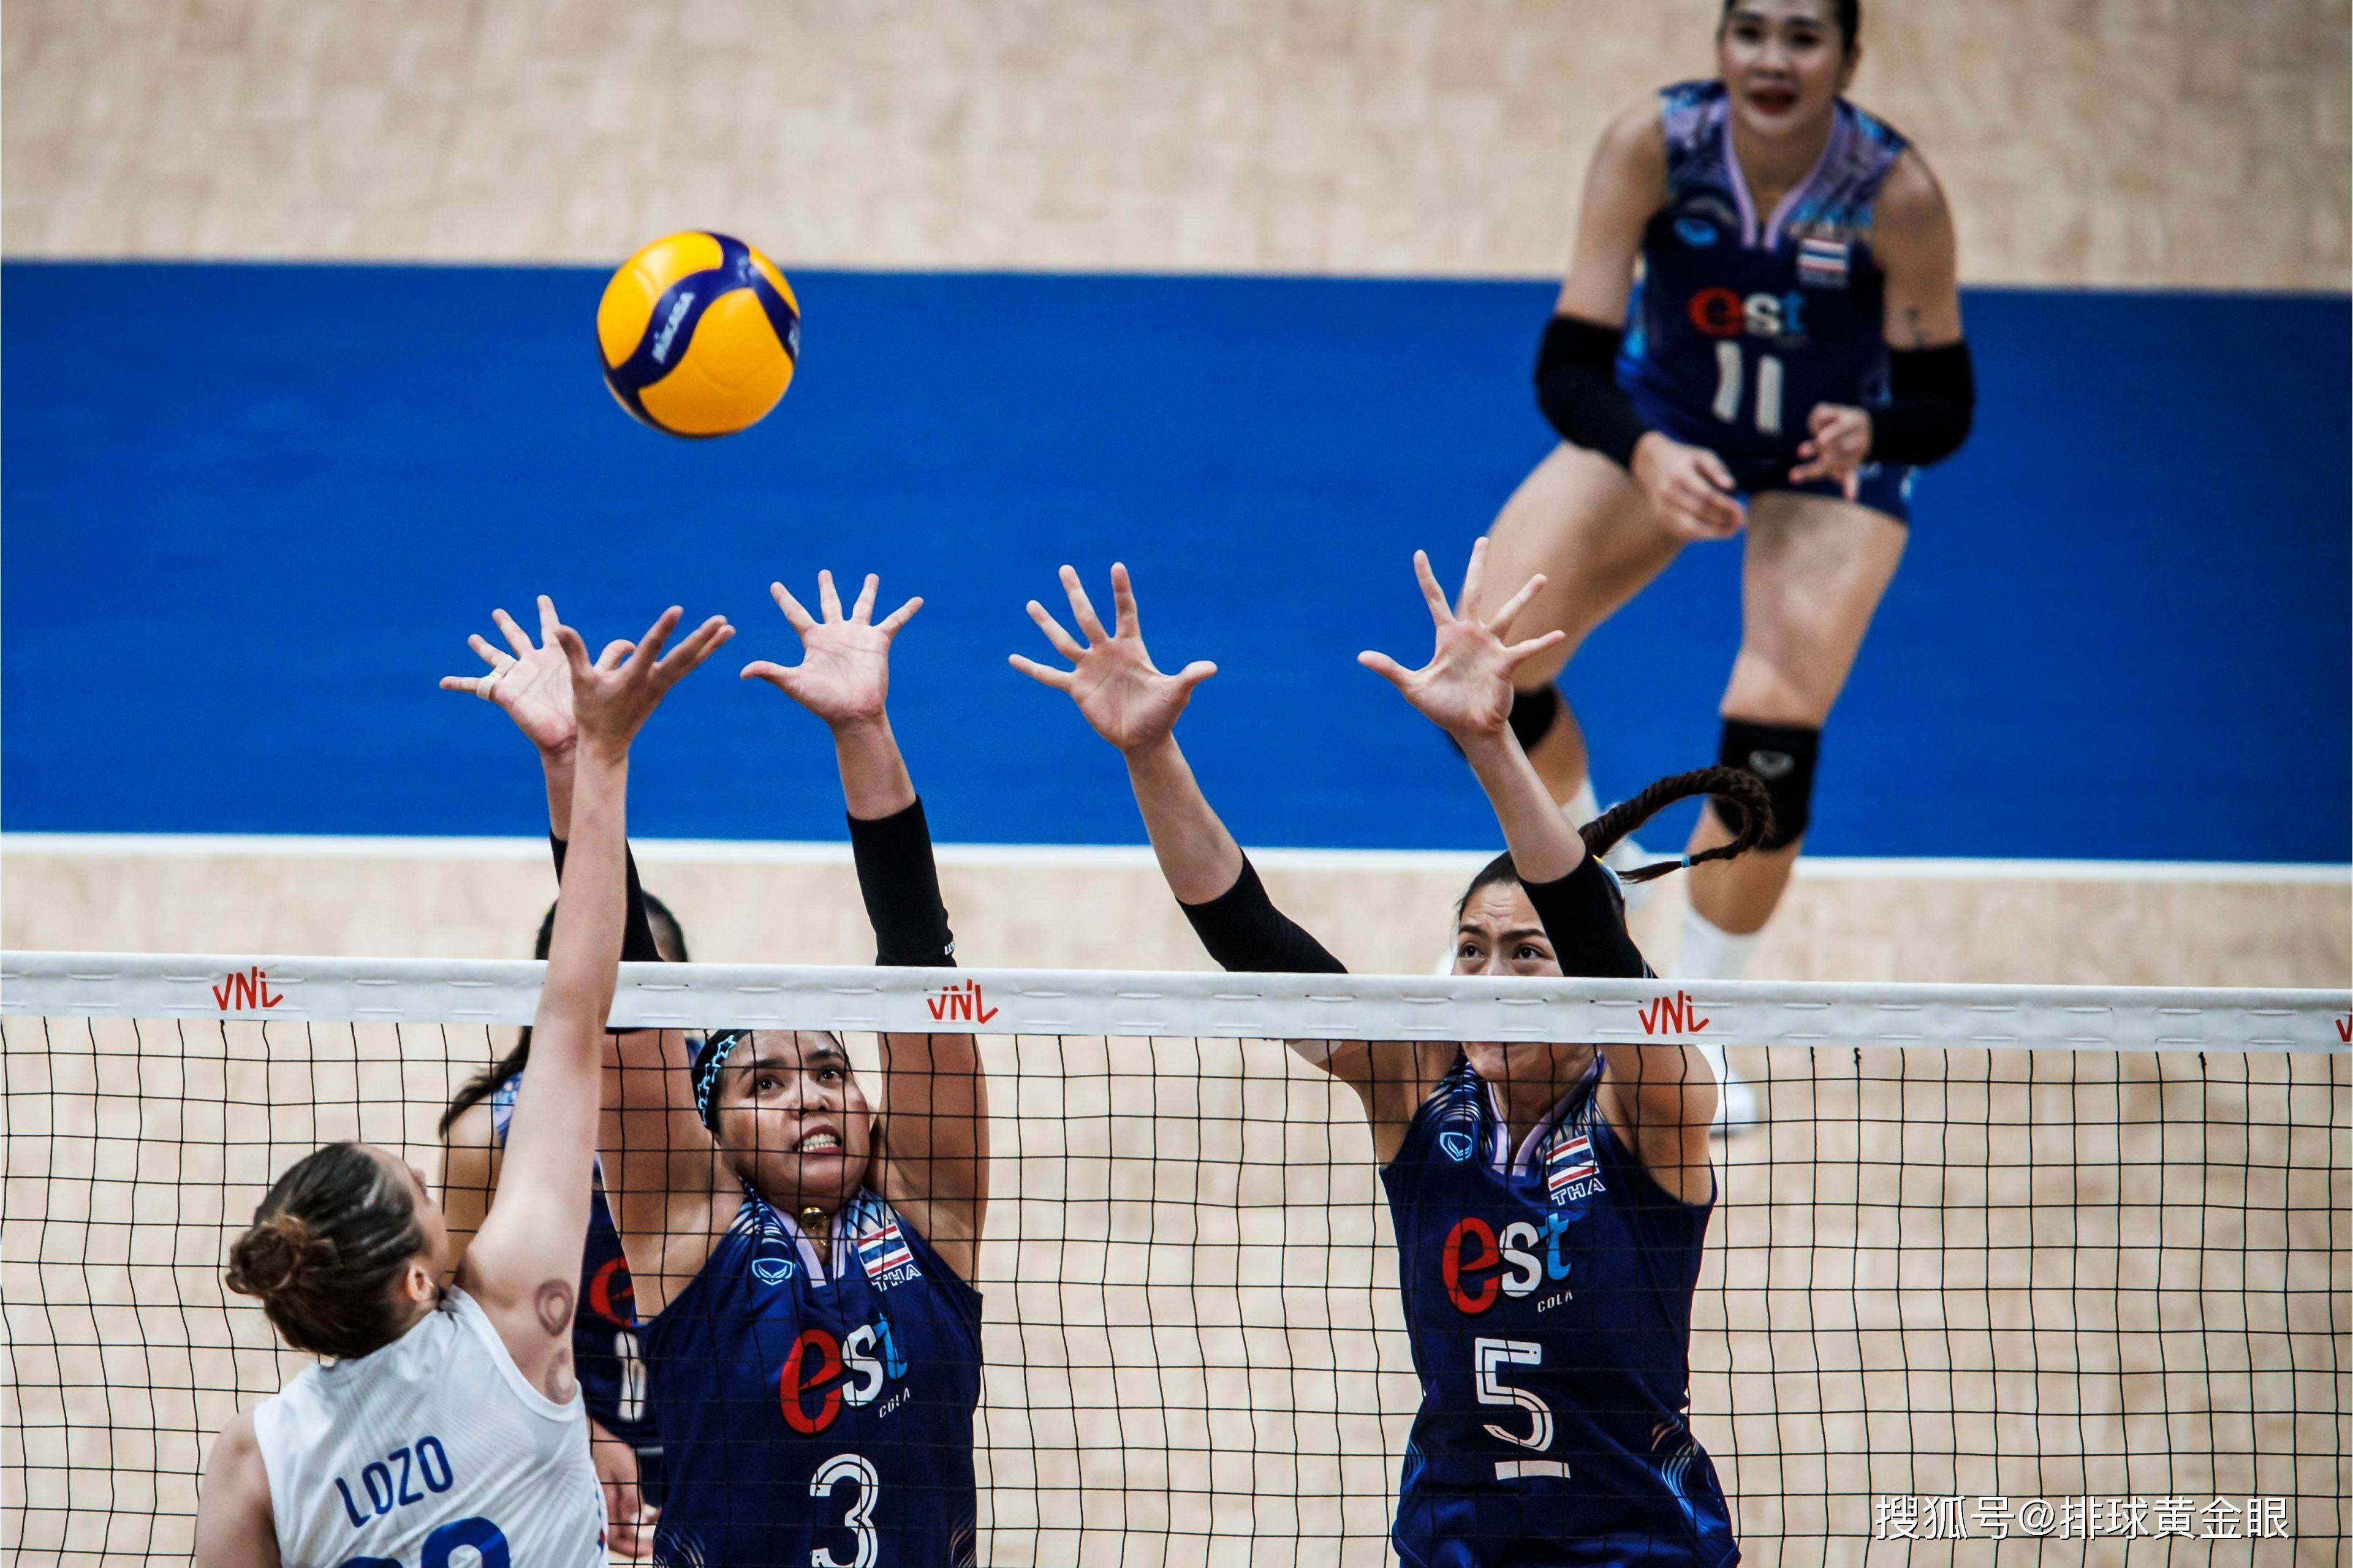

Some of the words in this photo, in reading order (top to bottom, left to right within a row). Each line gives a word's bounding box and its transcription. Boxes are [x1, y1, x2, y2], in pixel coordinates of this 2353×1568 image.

[1688, 287, 1803, 336] est
[1712, 341, 1783, 435] 11
[927, 979, 998, 1024] VNL
[1551, 1178, 1606, 1206] THA
[871, 1263, 922, 1292] THA
[1442, 1213, 1573, 1314] est
[1537, 1290, 1573, 1312] COLA
[779, 1312, 908, 1434] est
[879, 1387, 910, 1418] COLA
[1475, 1338, 1554, 1452] 5
[335, 1435, 453, 1528] LOZO
[809, 1453, 879, 1568] 3
